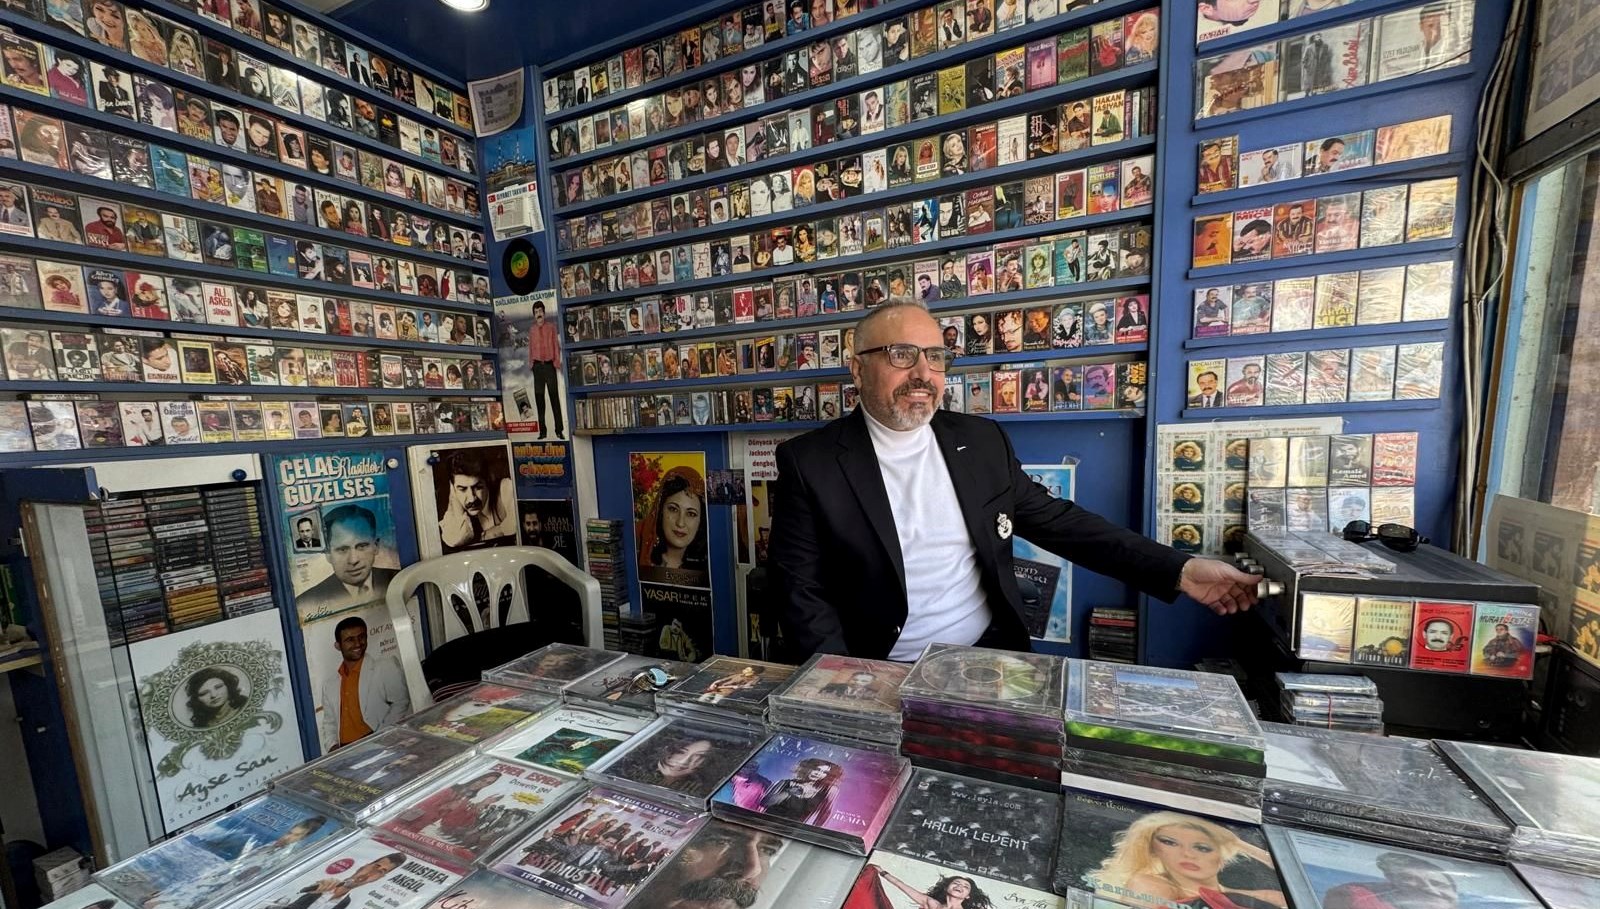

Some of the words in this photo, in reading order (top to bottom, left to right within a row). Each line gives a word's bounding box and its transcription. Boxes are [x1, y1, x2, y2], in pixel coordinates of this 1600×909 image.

[1095, 94, 1121, 105] HAKAN
[209, 296, 232, 307] ASKER
[951, 790, 1022, 810] www.leyla.com
[922, 818, 969, 837] HALUK
[972, 830, 1030, 851] LEVENT
[402, 860, 449, 885] MUSTAFA
